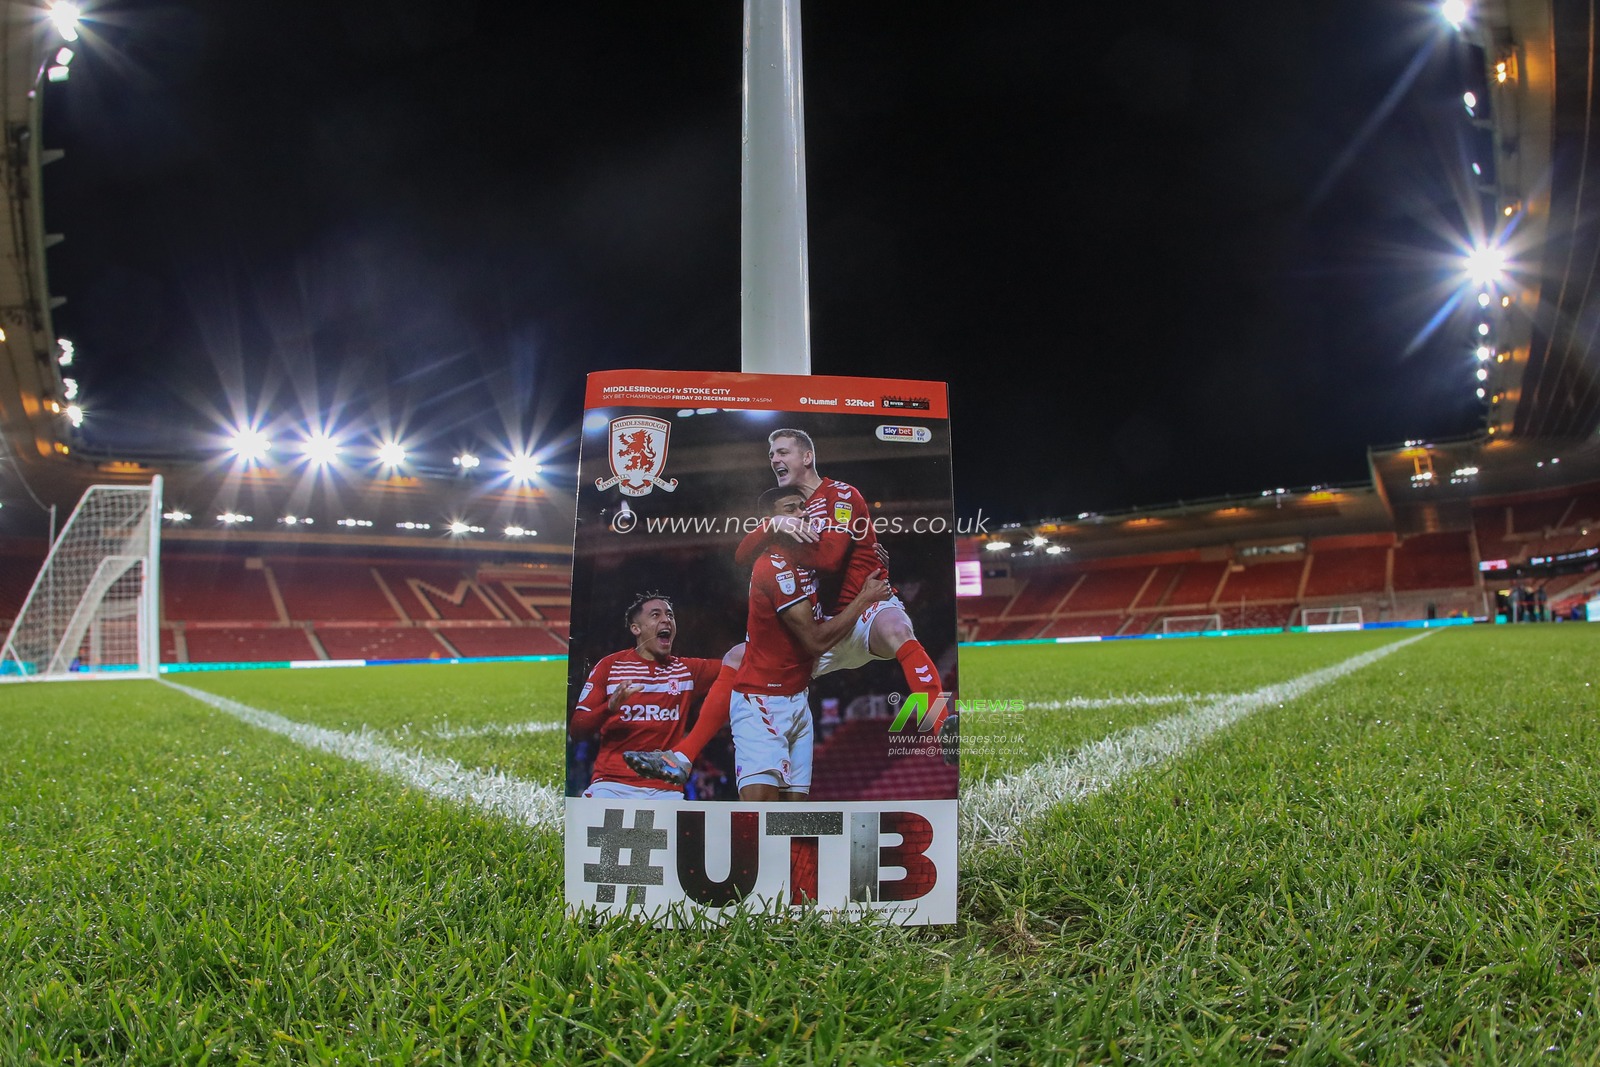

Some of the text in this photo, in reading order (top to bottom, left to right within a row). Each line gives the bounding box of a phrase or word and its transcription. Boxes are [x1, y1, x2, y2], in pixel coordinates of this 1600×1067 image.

[603, 386, 675, 394] MIDDLESBROUGH
[682, 387, 710, 395] STOKE
[808, 397, 838, 406] hummel
[845, 398, 875, 408] 32Red
[613, 420, 667, 430] MIDDLESBROUGH
[884, 427, 912, 435] sky bet
[619, 704, 680, 722] 32Red
[584, 808, 938, 907] #UTB
